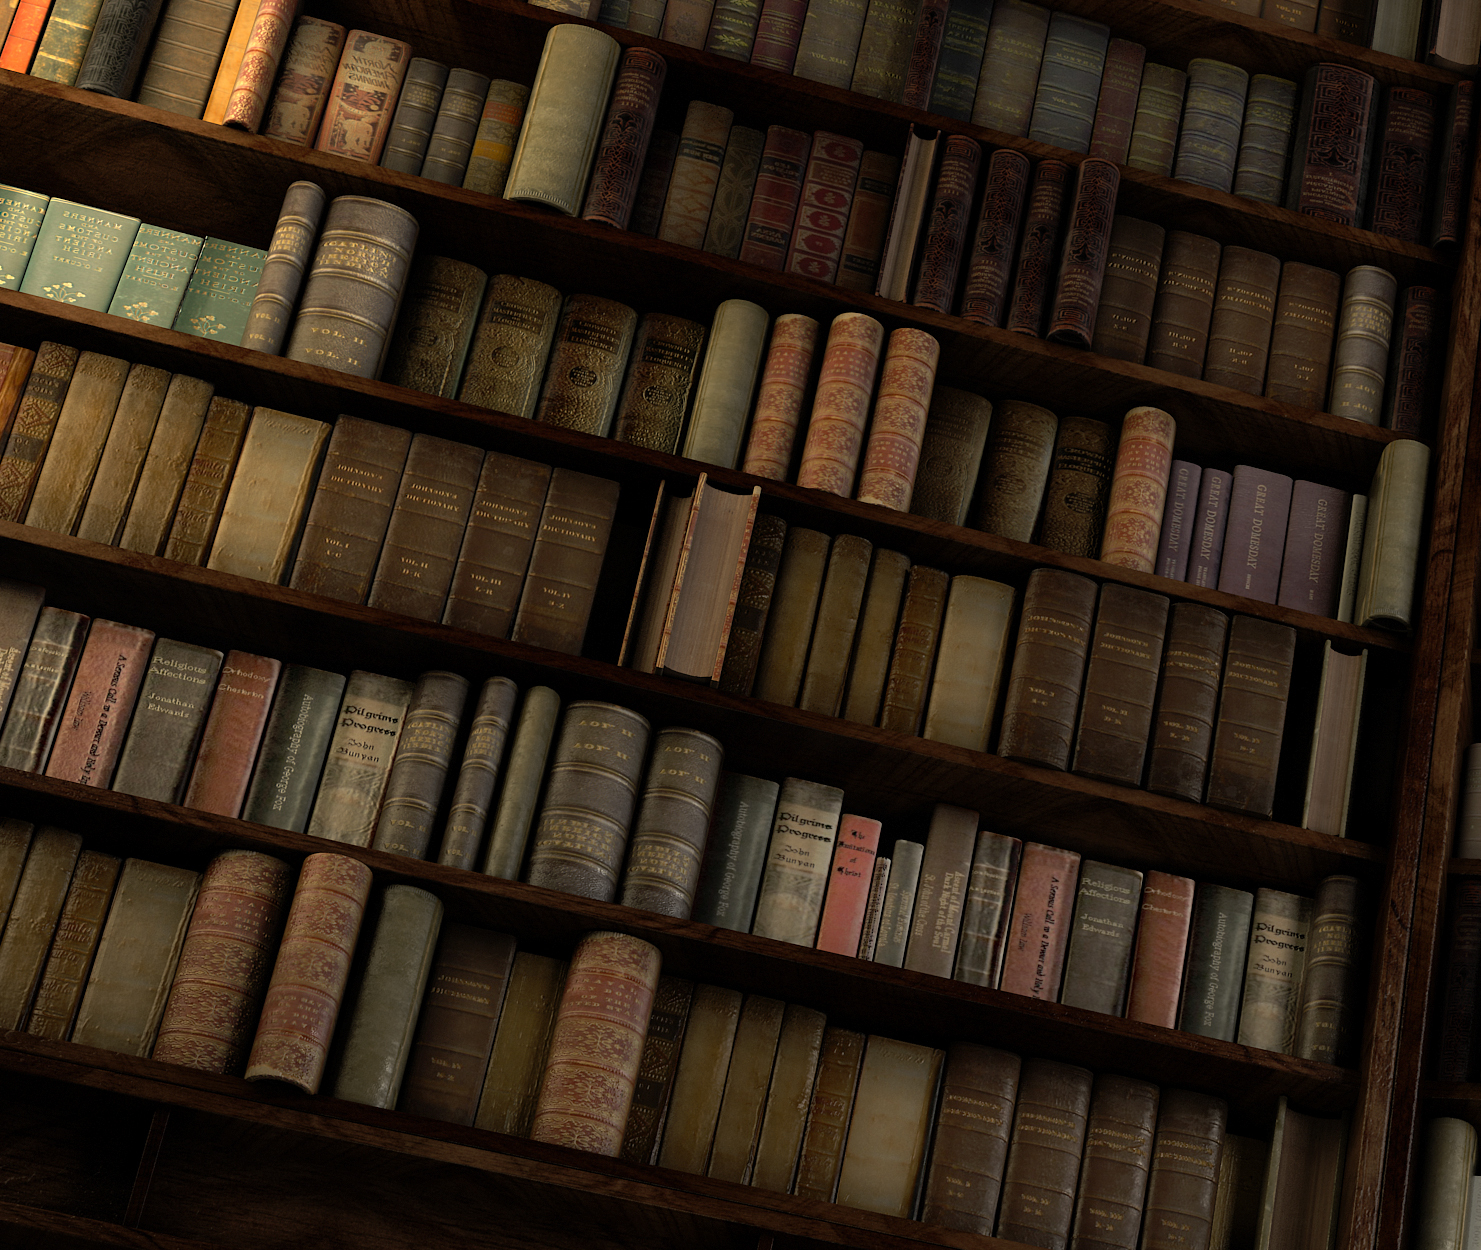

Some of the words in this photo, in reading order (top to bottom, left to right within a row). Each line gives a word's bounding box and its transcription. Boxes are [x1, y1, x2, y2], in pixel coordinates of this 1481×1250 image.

[1176, 468, 1189, 500] GREAT
[1210, 476, 1221, 507] GREAT
[1254, 484, 1267, 516] GREAT
[1315, 499, 1328, 531] GREAT
[1168, 502, 1184, 553] DOMESDAY
[1200, 509, 1217, 560] DOMESDAY
[1247, 518, 1263, 570] DOMESDAY
[1309, 533, 1324, 584] DOMESDAY
[153, 656, 207, 674] Religious
[149, 666, 206, 685] Affections
[148, 692, 195, 709] Jonathan
[147, 703, 190, 719] Edwards
[345, 705, 398, 725] Pilgrims
[289, 694, 314, 755] Autobiography
[340, 718, 396, 737] Progress
[275, 766, 294, 793] George
[272, 796, 286, 811] Fox
[780, 812, 833, 830] Pilgrims
[776, 824, 832, 843] Progress
[1078, 887, 1130, 904] Affections
[1082, 877, 1130, 895] Religious
[1081, 914, 1124, 929] Jonathan
[1082, 923, 1120, 938] Edwards
[1211, 912, 1228, 972] Autobiography
[1205, 982, 1218, 1009] George
[1203, 1012, 1214, 1027] Fox
